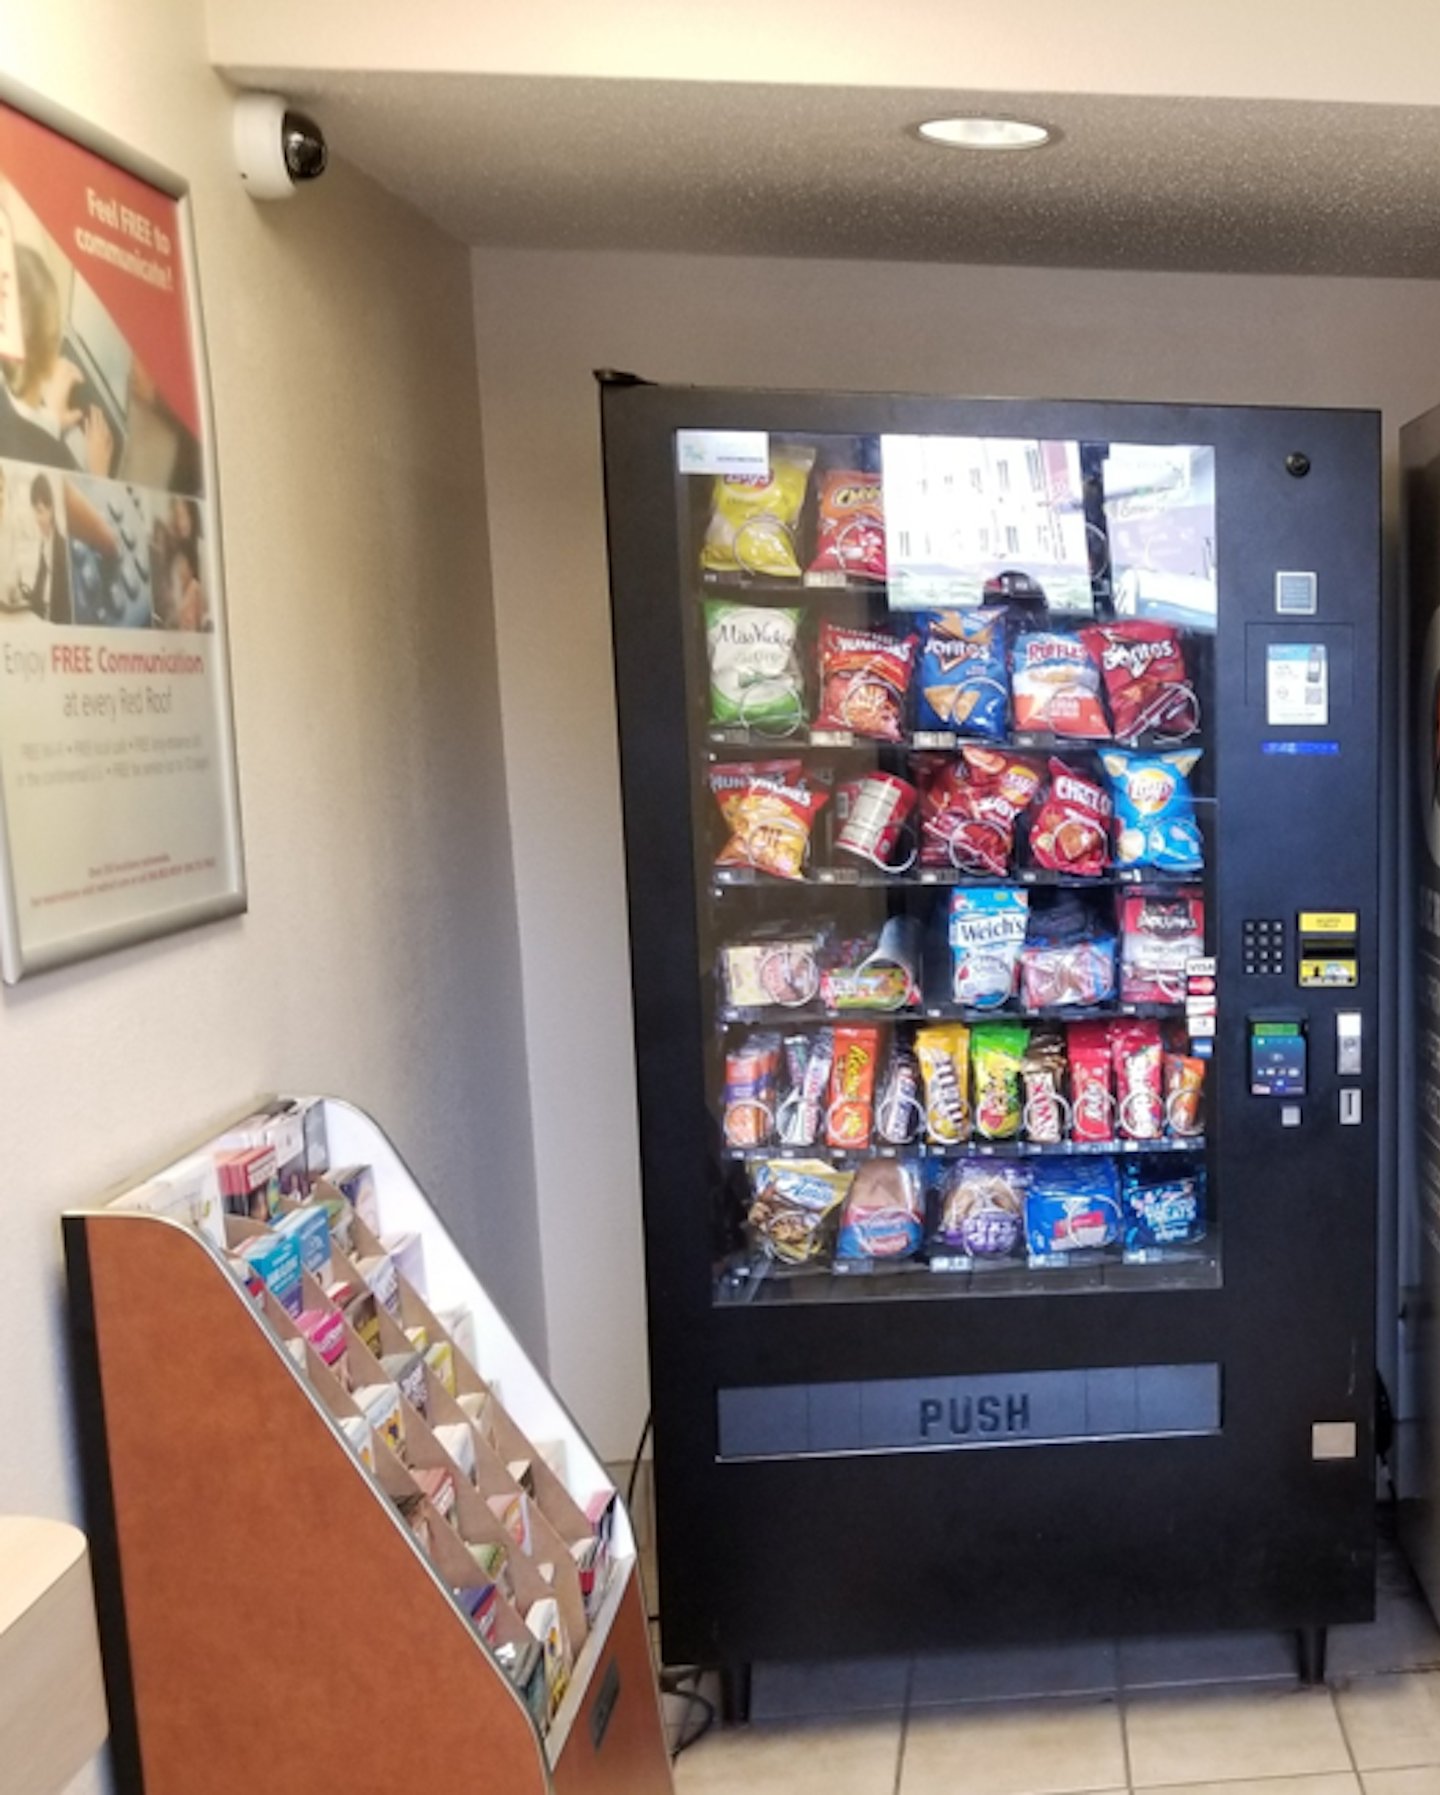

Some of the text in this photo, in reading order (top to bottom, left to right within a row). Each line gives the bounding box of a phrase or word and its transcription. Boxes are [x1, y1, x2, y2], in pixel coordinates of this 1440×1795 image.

[85, 186, 171, 255] Feel FREE to
[75, 226, 173, 292] communicate!
[4, 642, 204, 682] Enjoy FREE Communication
[64, 685, 173, 723] at every Red Roof
[960, 914, 1025, 942] Welch's
[919, 1393, 1030, 1437] PUSH
